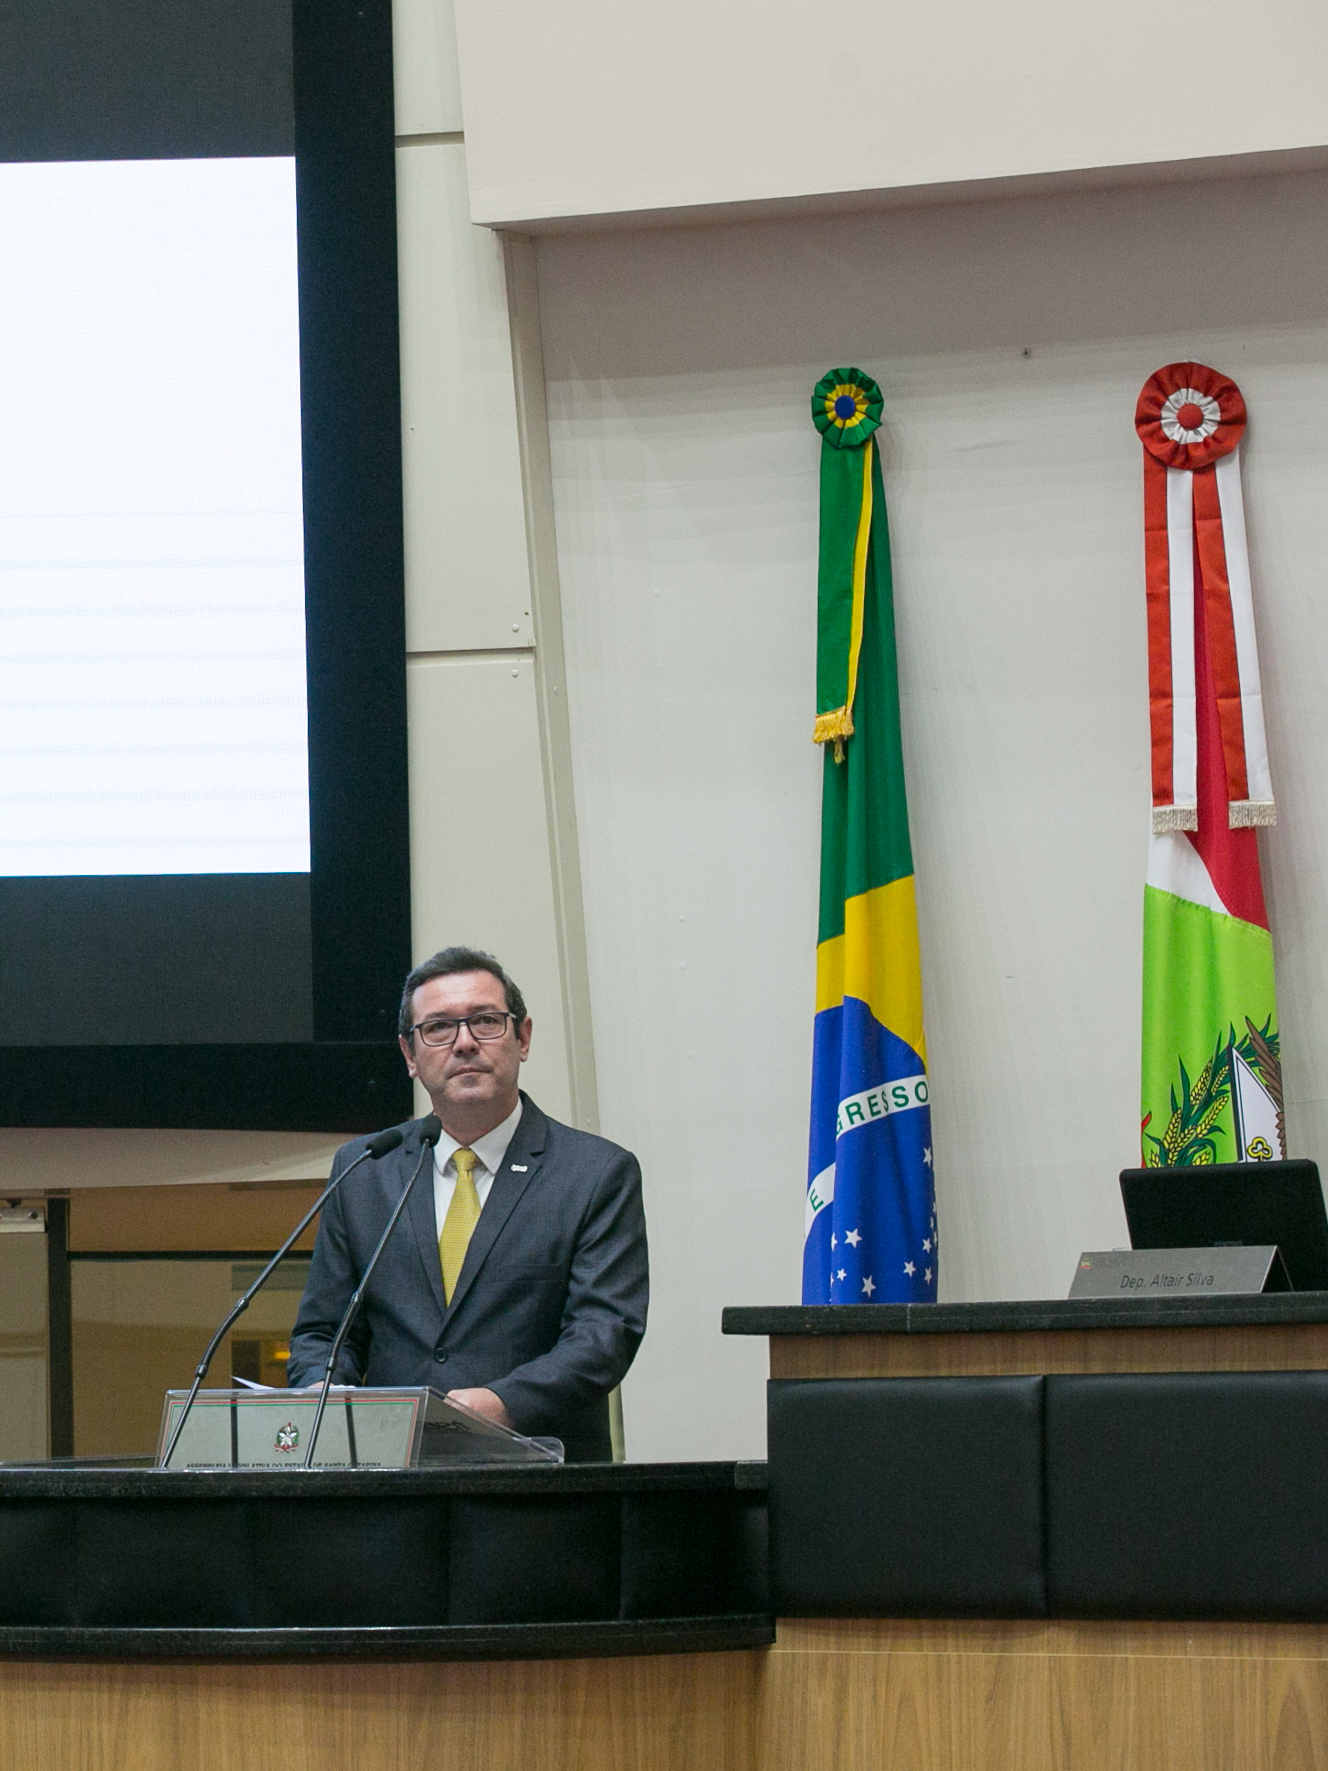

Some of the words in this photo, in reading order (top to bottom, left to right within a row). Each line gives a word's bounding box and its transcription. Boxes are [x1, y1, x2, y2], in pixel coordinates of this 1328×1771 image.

[1120, 1275, 1147, 1291] Dep.
[1150, 1273, 1184, 1288] Altair
[1186, 1272, 1215, 1287] Silva
